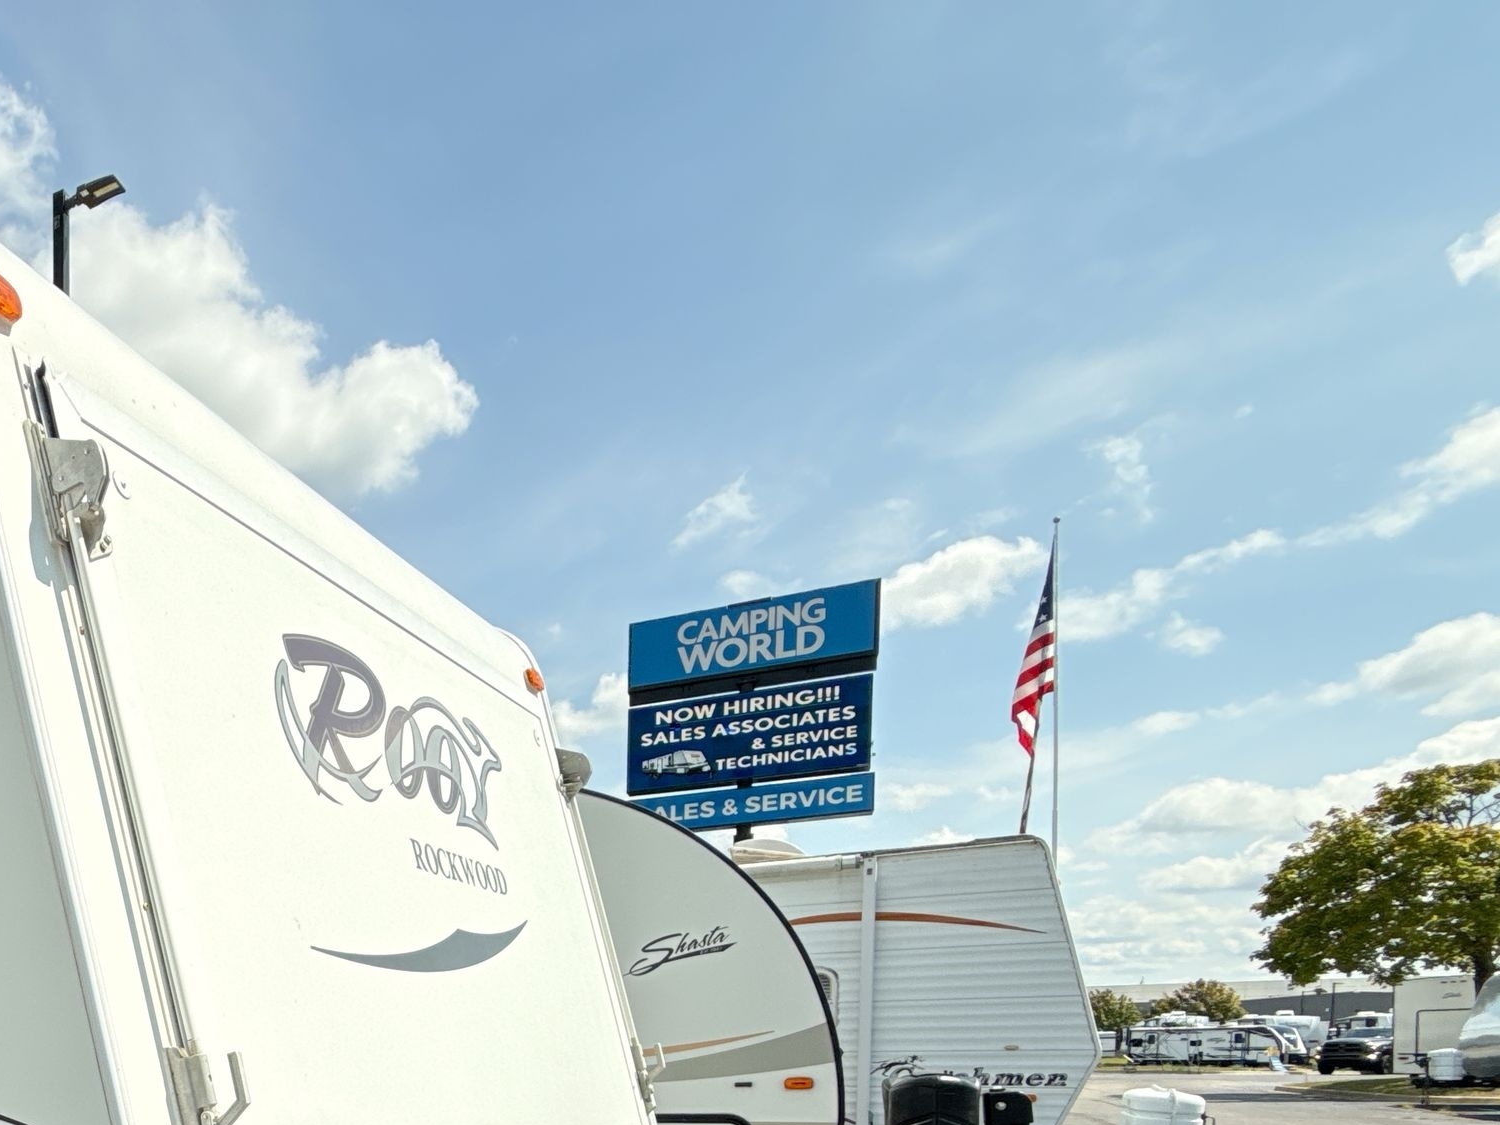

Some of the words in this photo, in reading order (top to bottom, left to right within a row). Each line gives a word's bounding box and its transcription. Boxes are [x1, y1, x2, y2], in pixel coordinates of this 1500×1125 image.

[677, 598, 826, 645] CAMPING
[678, 625, 825, 674] WORLD
[655, 704, 715, 725] NOW
[723, 686, 840, 715] HIRING!!!
[641, 726, 705, 747] SALES
[712, 706, 856, 738] ASSOCIATES
[752, 738, 765, 750] &
[771, 725, 858, 748] SERVICE
[716, 743, 857, 770] TECHNICIANS
[655, 800, 715, 821] ALES
[722, 799, 738, 816] &
[744, 784, 863, 813] SERVICE
[409, 838, 507, 895] ROCKWOOD
[624, 926, 731, 976] Shasta
